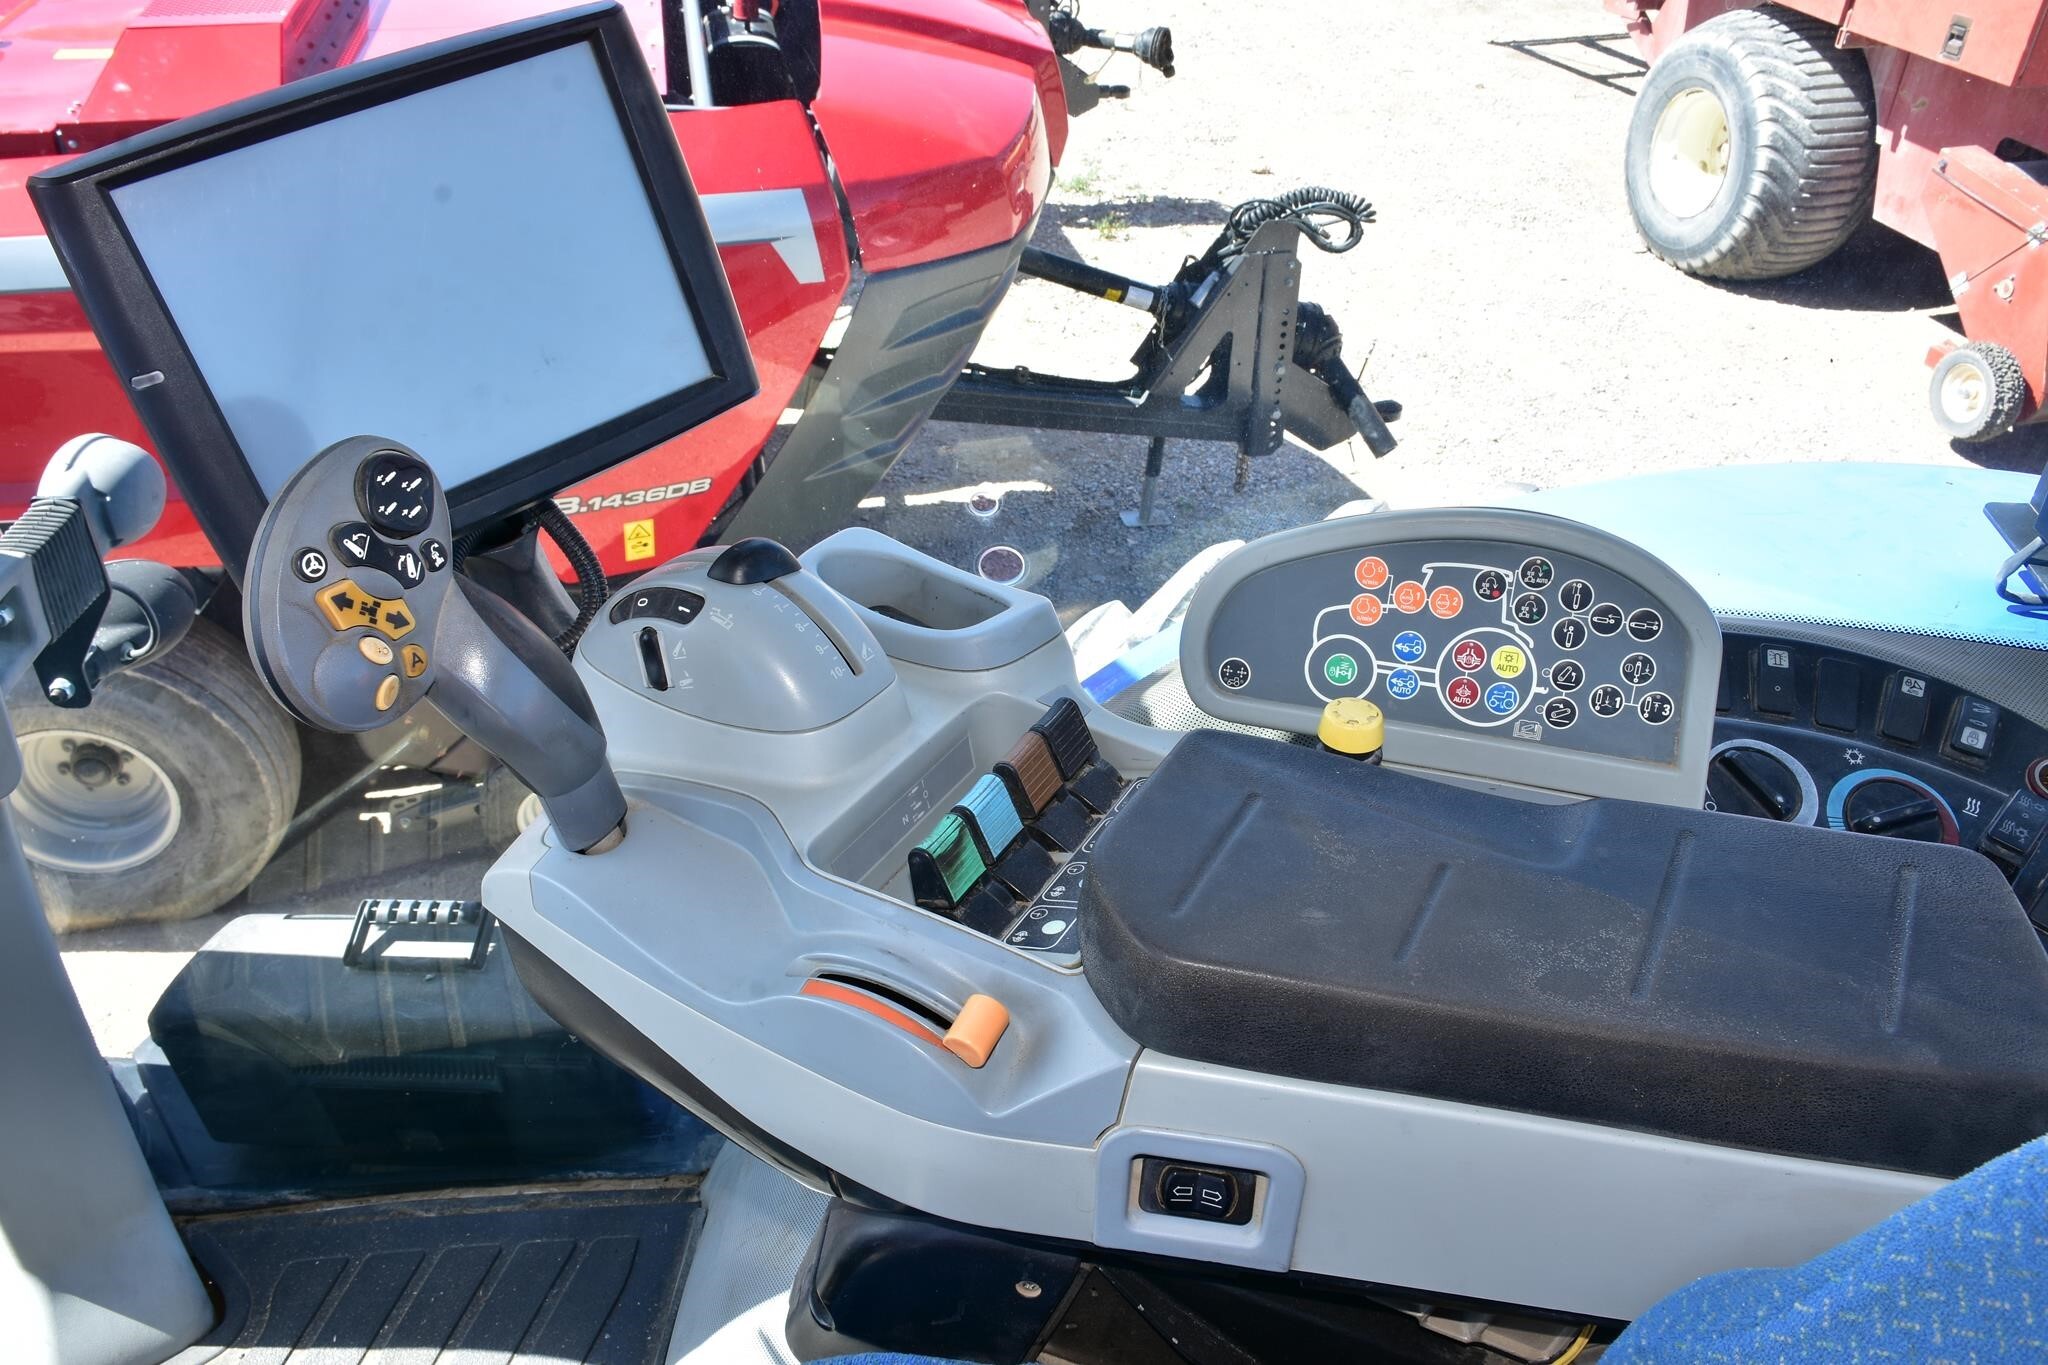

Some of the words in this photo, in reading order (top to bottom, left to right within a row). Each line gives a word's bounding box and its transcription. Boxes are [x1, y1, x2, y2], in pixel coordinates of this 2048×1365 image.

[412, 652, 424, 668] A
[1496, 663, 1518, 673] AUTO
[1392, 686, 1411, 695] AUTO
[1453, 696, 1471, 704] AUTO
[1615, 697, 1621, 709] 1
[1662, 705, 1670, 716] 3
